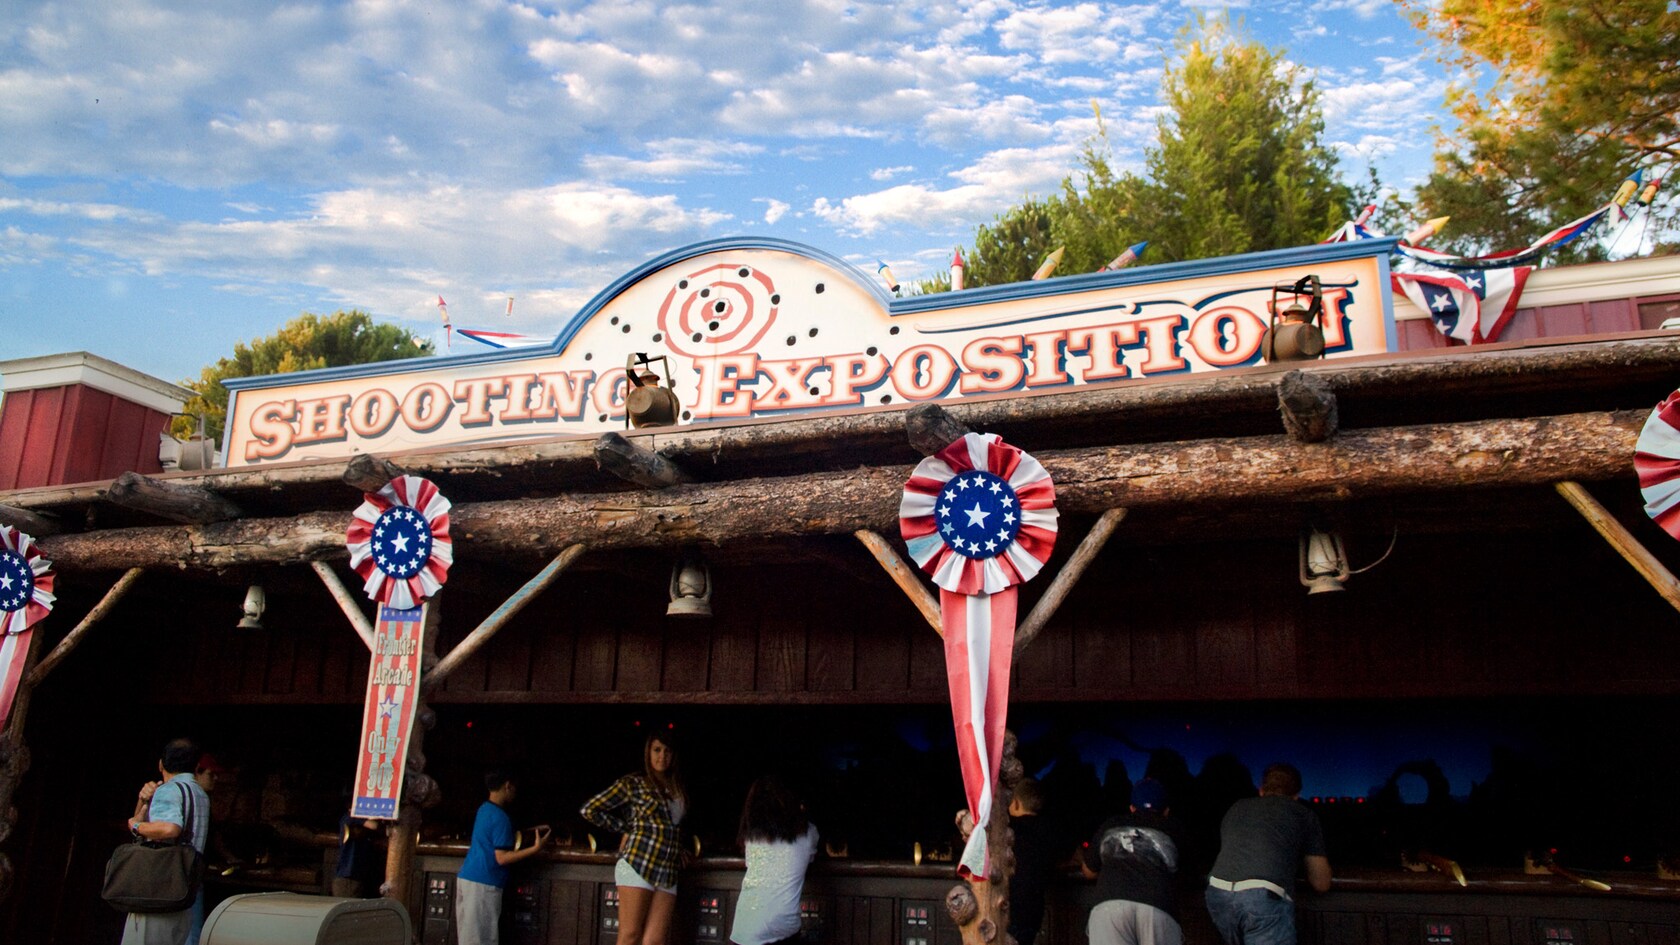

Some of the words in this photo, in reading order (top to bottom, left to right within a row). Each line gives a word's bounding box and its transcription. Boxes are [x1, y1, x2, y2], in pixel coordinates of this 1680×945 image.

[377, 632, 417, 656] Frontier
[373, 662, 412, 687] Arcade
[367, 730, 401, 760] Only
